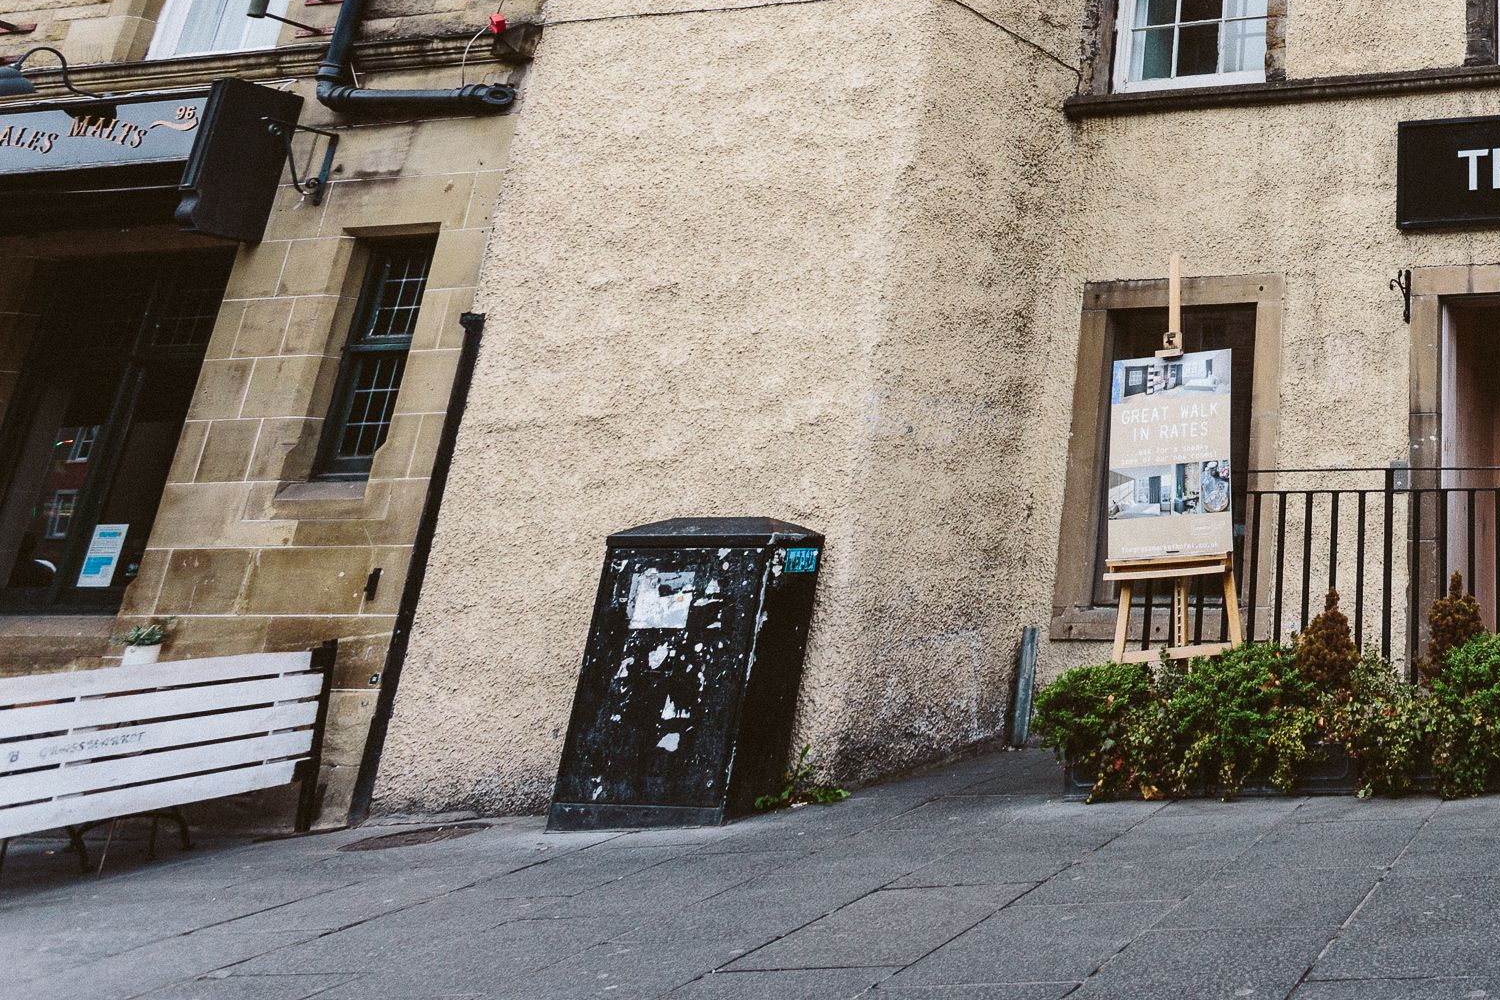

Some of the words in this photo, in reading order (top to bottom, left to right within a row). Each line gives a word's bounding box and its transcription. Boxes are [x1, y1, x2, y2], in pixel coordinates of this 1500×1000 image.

[0, 125, 59, 153] ALES
[69, 116, 149, 148] MALTS
[1121, 405, 1169, 425] GREAT
[1180, 402, 1218, 419] WALK
[1133, 427, 1149, 442] IN
[1160, 421, 1208, 440] RATES
